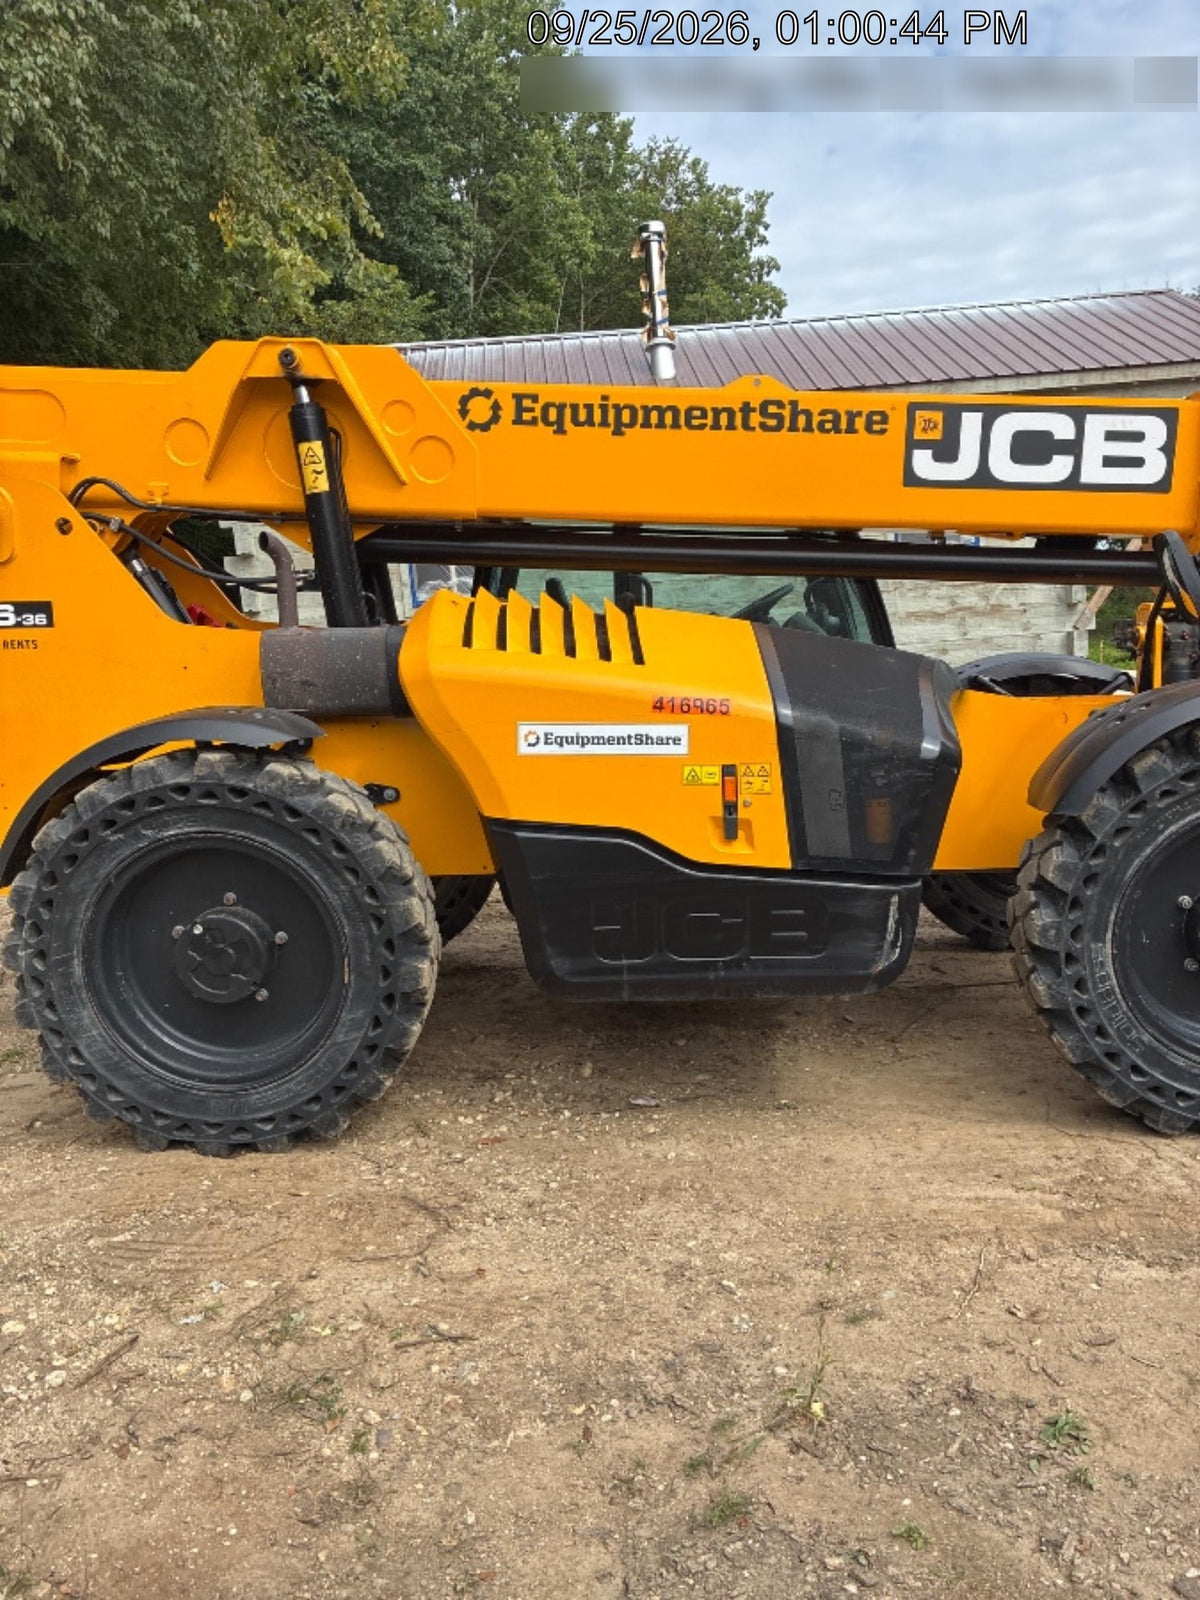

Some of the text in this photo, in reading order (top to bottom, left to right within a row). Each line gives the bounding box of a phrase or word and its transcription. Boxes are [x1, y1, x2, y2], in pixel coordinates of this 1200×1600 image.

[512, 393, 889, 437] EquipmentShare
[911, 411, 1169, 485] JCB
[652, 696, 730, 716] 416965
[543, 731, 682, 749] EquipmentShare
